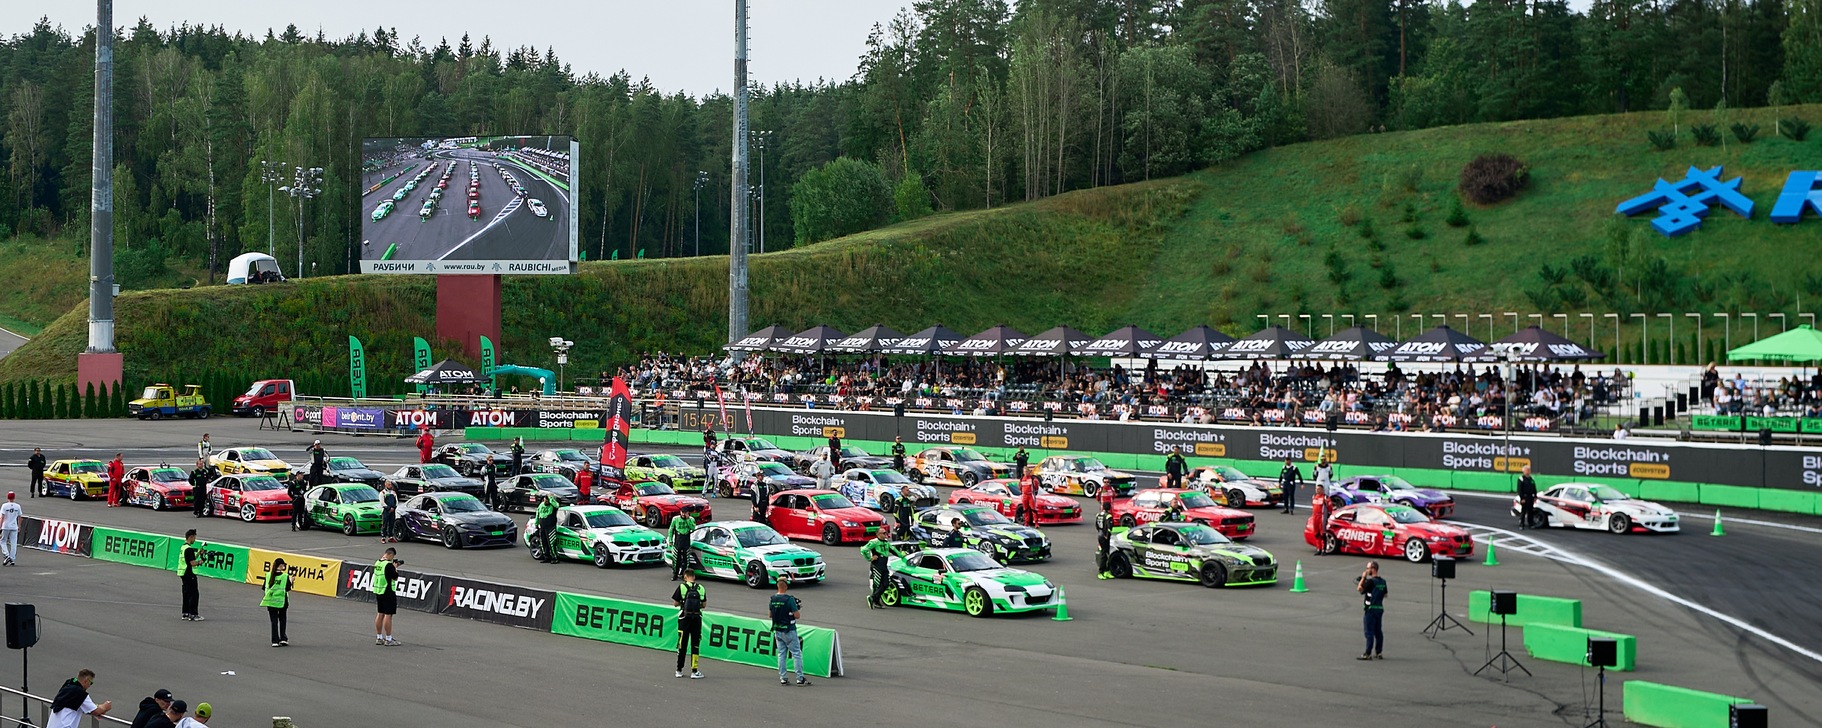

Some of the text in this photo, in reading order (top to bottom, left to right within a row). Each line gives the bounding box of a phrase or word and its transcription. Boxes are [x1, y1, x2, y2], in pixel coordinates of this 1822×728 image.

[784, 337, 818, 346] ATOM
[838, 338, 871, 346] ATOM
[960, 339, 998, 348] ATOM
[1020, 340, 1061, 348] ATOM
[1088, 340, 1130, 349] ATOM
[1160, 341, 1202, 351] ATOM
[1230, 340, 1275, 350] ATOM
[1313, 341, 1360, 350] ATOM
[1396, 342, 1446, 352] ATOM
[1491, 342, 1539, 352] TOM
[1044, 402, 1062, 410] ATOM
[1148, 406, 1168, 414] ATOM
[1224, 408, 1245, 417] ATOM
[1263, 409, 1285, 418] ATOM
[1304, 410, 1326, 420] ATOM
[1345, 412, 1368, 421] ATOM
[396, 412, 436, 425] ATOM
[471, 412, 514, 425] ATOM
[792, 415, 839, 425] Blockchain
[1388, 413, 1411, 423] ATOM
[1432, 415, 1456, 425] ATOM
[1477, 416, 1502, 426] ATOM
[1524, 418, 1550, 428] ATOM
[540, 420, 573, 428] Sports
[917, 420, 970, 431] Blockchain
[792, 425, 822, 435] Sports
[1004, 424, 1062, 435] Blockchain
[917, 431, 950, 442] Sports
[1004, 434, 1039, 446] Sports
[1154, 430, 1218, 441] Blockchain
[1260, 434, 1329, 447] Blockchain
[1260, 447, 1303, 459] Sports
[1443, 442, 1522, 456] Blockchain
[1574, 446, 1659, 462] Blockchain
[1443, 455, 1492, 469] Sports
[1574, 460, 1627, 475] Sports
[1135, 511, 1166, 522] FONB
[38, 520, 80, 550] ATOM
[1337, 528, 1378, 542] FONBET
[1145, 551, 1184, 562] Blockchain
[1145, 559, 1169, 567] Sports
[264, 561, 324, 580] ВИНА
